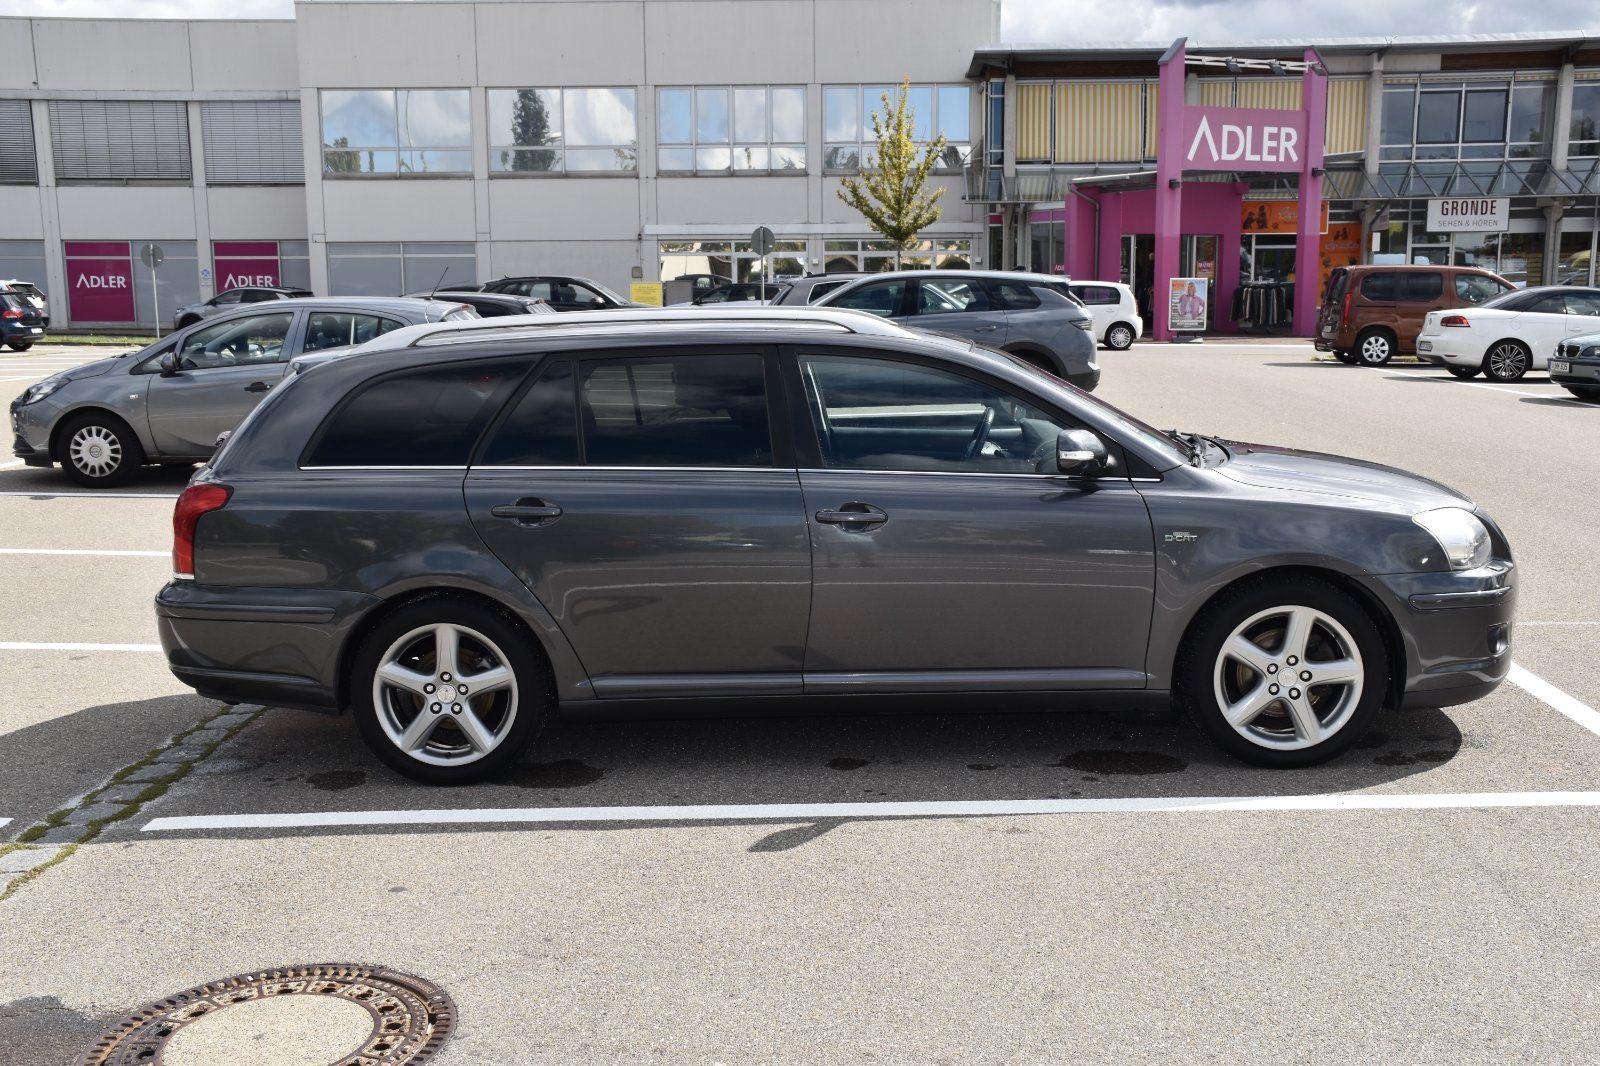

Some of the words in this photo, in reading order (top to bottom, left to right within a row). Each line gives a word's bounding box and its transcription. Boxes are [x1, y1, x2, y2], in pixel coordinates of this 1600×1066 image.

[1187, 114, 1298, 162] ADLER
[1441, 200, 1497, 216] GRONDE
[76, 273, 126, 289] ADLER
[224, 273, 274, 288] ADLER
